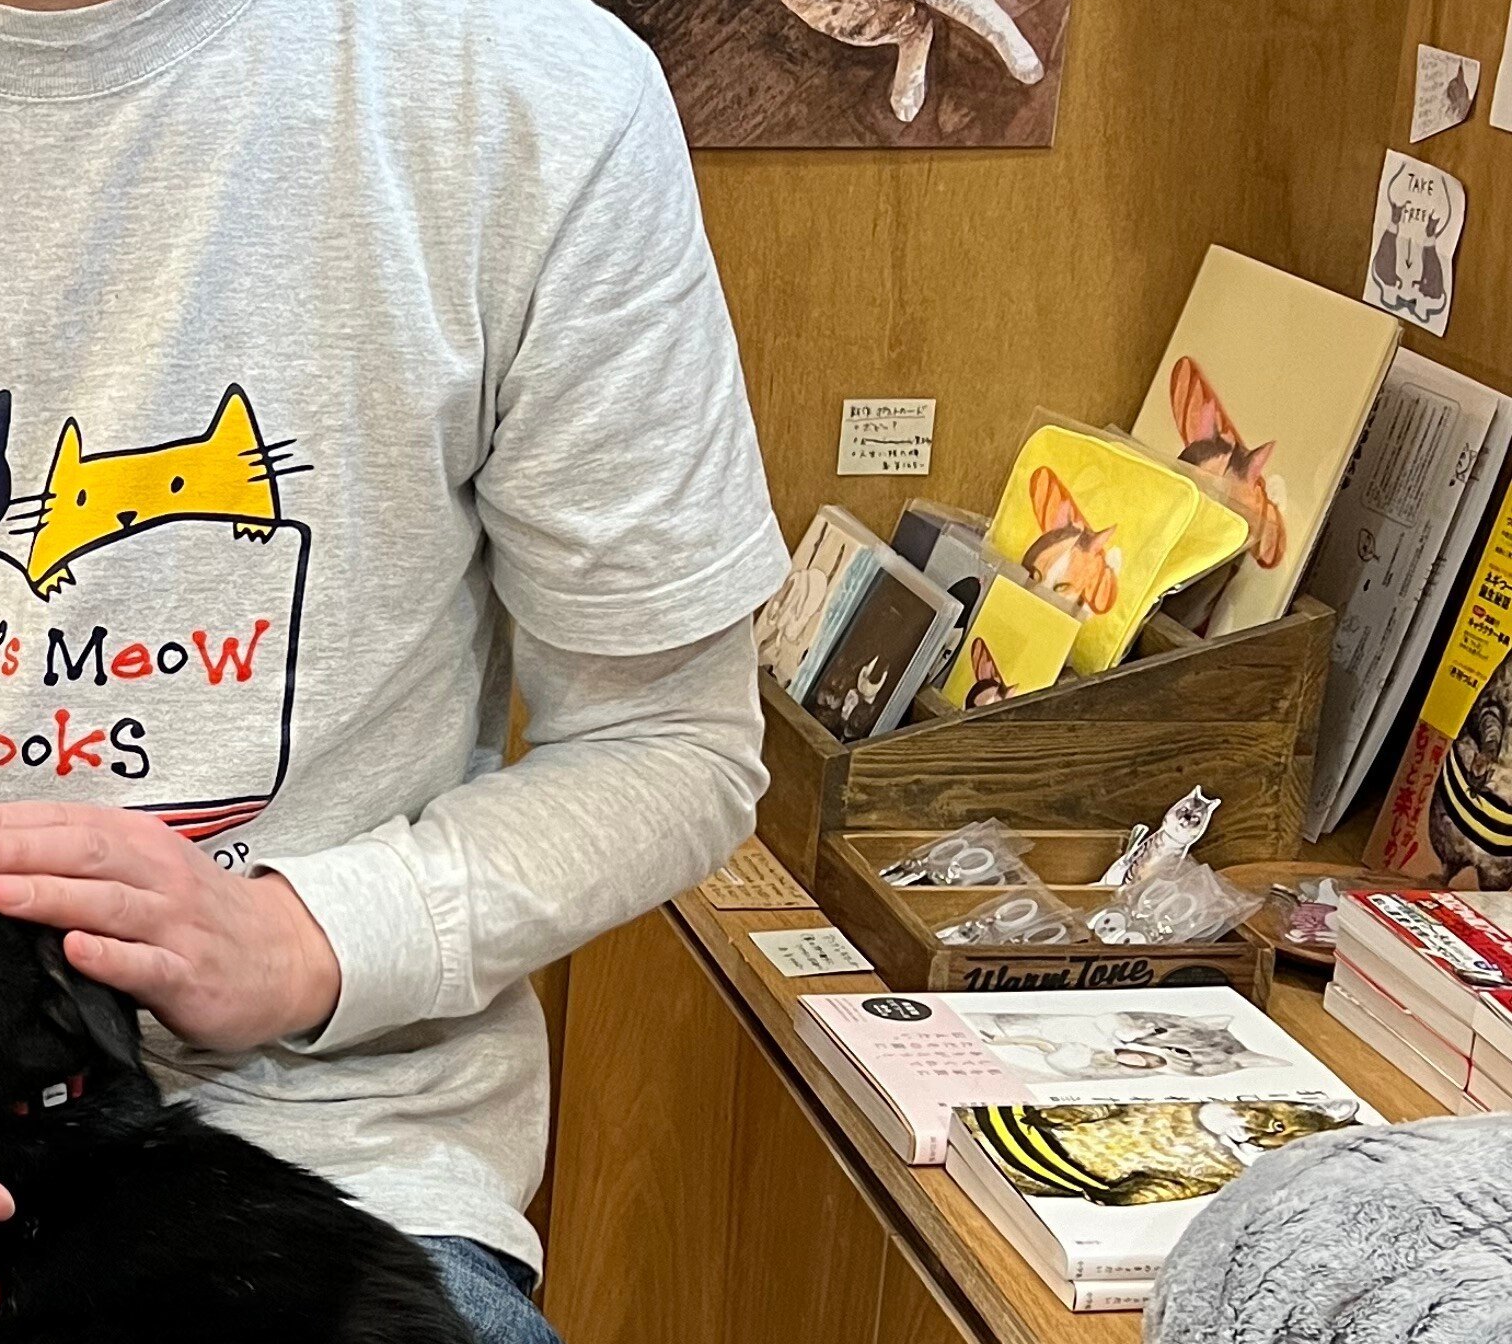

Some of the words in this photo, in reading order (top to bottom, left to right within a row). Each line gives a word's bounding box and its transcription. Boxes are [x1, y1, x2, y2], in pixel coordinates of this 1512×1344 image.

[1407, 172, 1434, 197] TAKE
[1401, 200, 1428, 224] FREE
[1069, 955, 1155, 988] Tone
